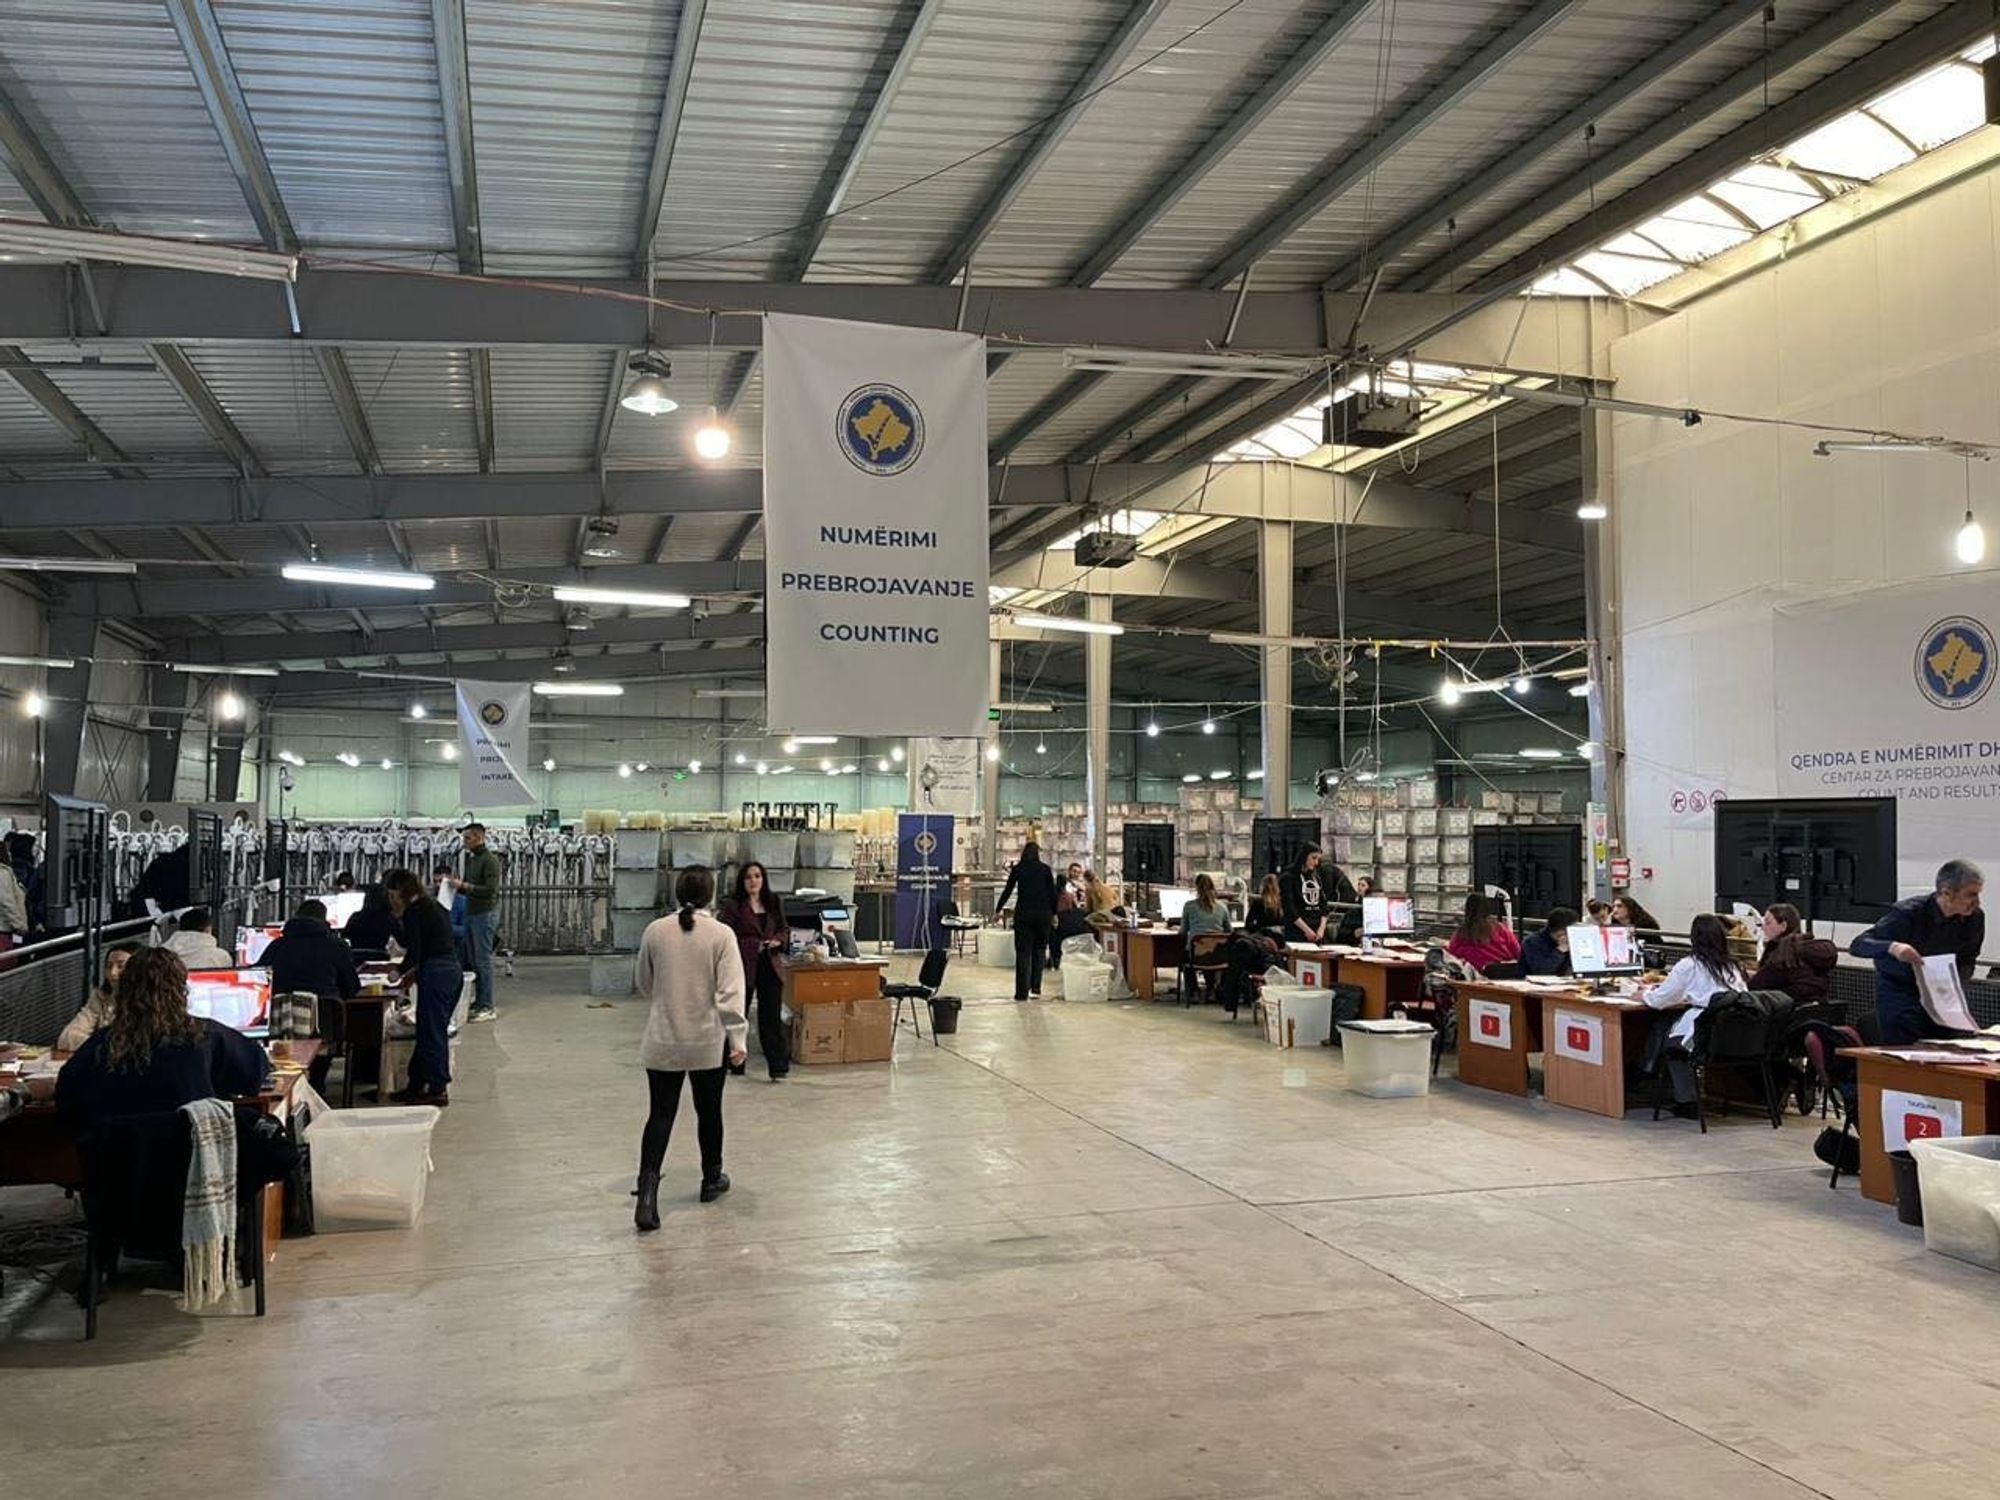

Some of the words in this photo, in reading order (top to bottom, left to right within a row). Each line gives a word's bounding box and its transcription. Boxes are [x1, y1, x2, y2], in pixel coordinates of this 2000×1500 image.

[820, 525, 937, 548] NUMËRIMI
[781, 573, 975, 598] PREBROJAVANJE
[820, 623, 939, 644] COUNTING
[1790, 752, 1856, 770] QENDRA
[1861, 750, 1870, 764] E
[1875, 743, 1974, 763] NUMËRIMIT
[1822, 770, 1872, 784] CENTAR
[1875, 769, 1892, 782] ZA
[1896, 763, 2000, 780] PREBROJAVAN
[1909, 785, 1940, 799] AND
[1944, 783, 2000, 798] RESULT
[1919, 1122, 1927, 1136] 2
